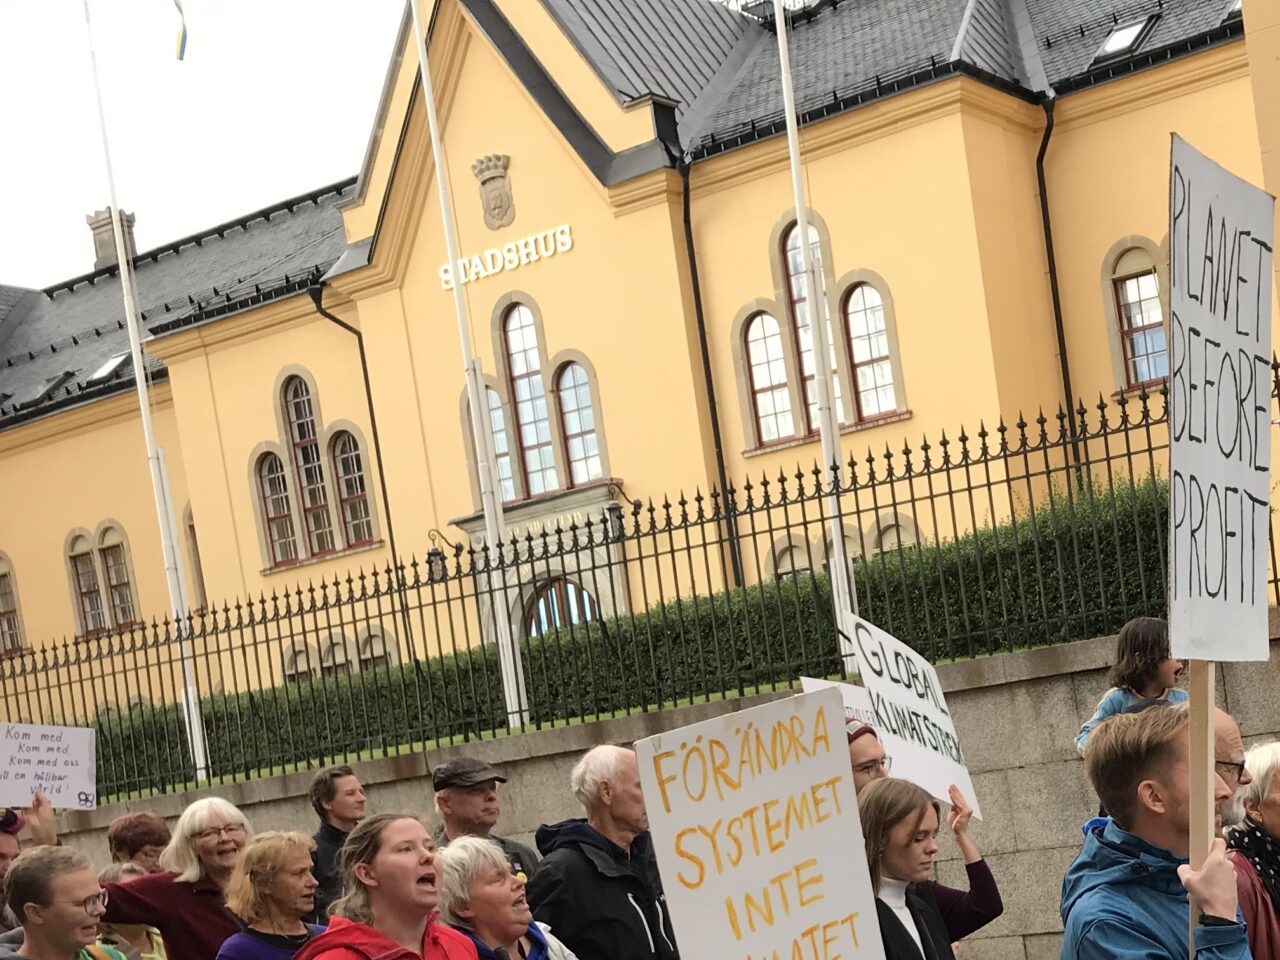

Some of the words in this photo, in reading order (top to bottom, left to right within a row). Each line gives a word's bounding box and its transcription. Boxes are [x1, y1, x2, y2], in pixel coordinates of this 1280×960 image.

[439, 224, 573, 290] STADSHUS
[1172, 165, 1273, 343] PLANET
[1172, 310, 1270, 471] BEFORE
[1173, 470, 1269, 607] PROFIT
[855, 622, 948, 715] GLOBAL
[5, 725, 31, 740] Kom
[40, 731, 63, 742] med
[9, 755, 31, 766] Kom
[36, 758, 58, 767] med
[17, 743, 40, 753] Kom
[47, 744, 70, 754] med
[653, 705, 831, 813] FÖRÄNDRA
[674, 775, 844, 890] SYSTEMET
[725, 859, 825, 941] INTE
